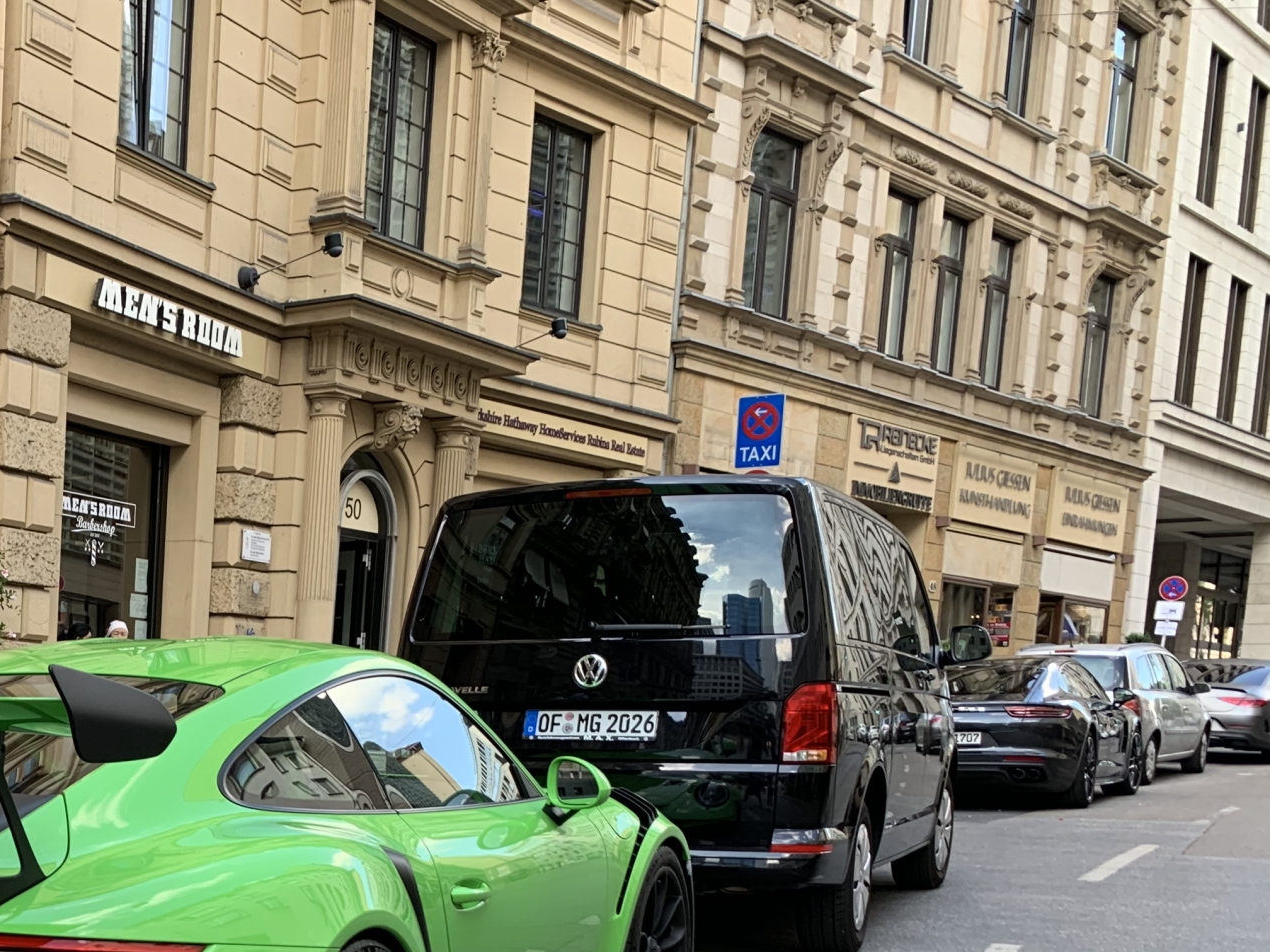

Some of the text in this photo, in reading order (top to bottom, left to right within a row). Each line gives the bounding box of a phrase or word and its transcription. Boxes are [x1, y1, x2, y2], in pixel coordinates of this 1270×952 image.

[96, 277, 244, 359] MEN'S ROOM
[503, 414, 539, 436] Hathaway
[610, 439, 626, 454] Real
[626, 442, 646, 458] Estate
[739, 444, 777, 463] TAXI
[965, 461, 1032, 492] JULIUS GIESSEN
[62, 495, 132, 523] MEN'S ROOM
[344, 497, 362, 520] 50
[75, 515, 116, 538] Barbershop
[538, 713, 655, 734] OF MG 2026
